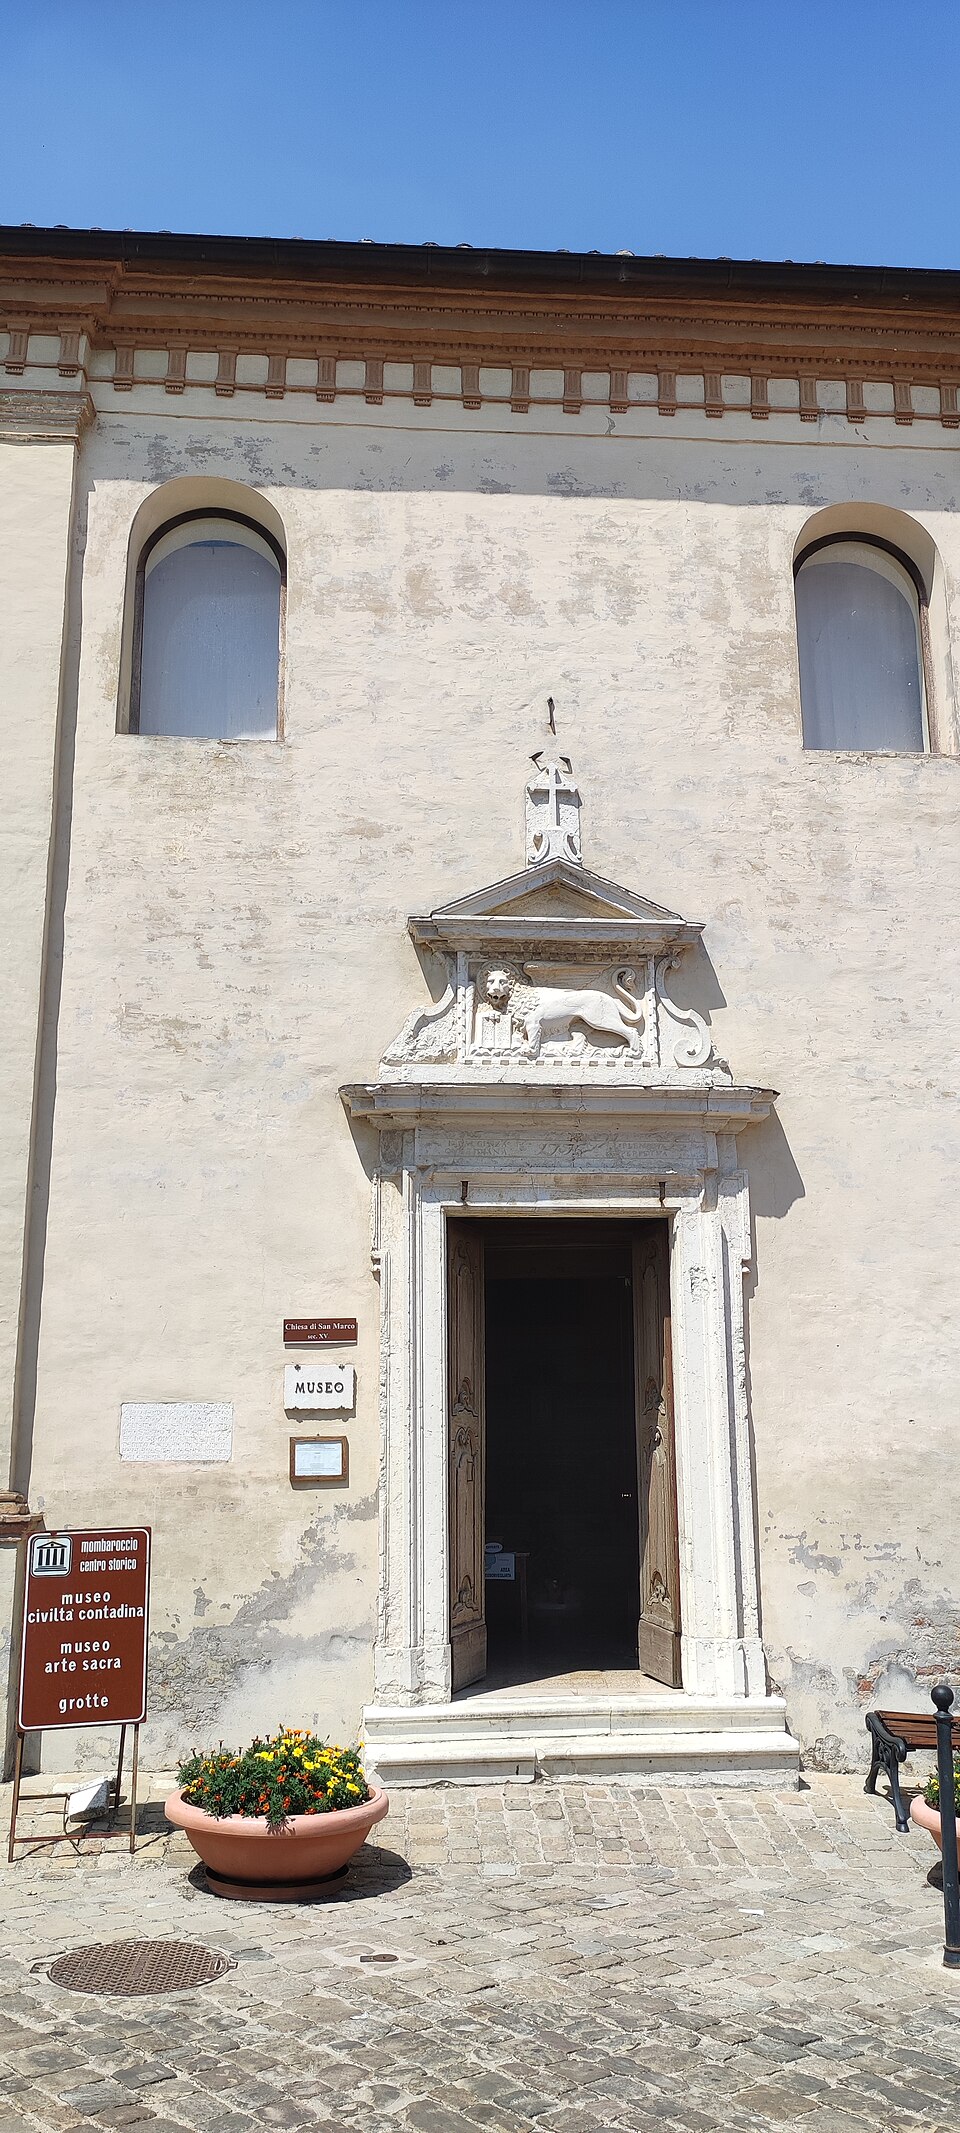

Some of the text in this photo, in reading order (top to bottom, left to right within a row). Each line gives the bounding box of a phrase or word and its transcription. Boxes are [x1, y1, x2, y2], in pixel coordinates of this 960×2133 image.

[285, 1323, 308, 1331] Chiesa
[332, 1322, 356, 1330] Marco
[295, 1382, 344, 1394] MUSEO
[80, 1537, 138, 1553] mombaroccio
[80, 1557, 137, 1572] centro storico
[61, 1591, 111, 1605] museo
[78, 1604, 144, 1620] contadina
[60, 1640, 110, 1654] museo
[44, 1657, 121, 1674] arte sacra
[58, 1695, 109, 1714] grotte
